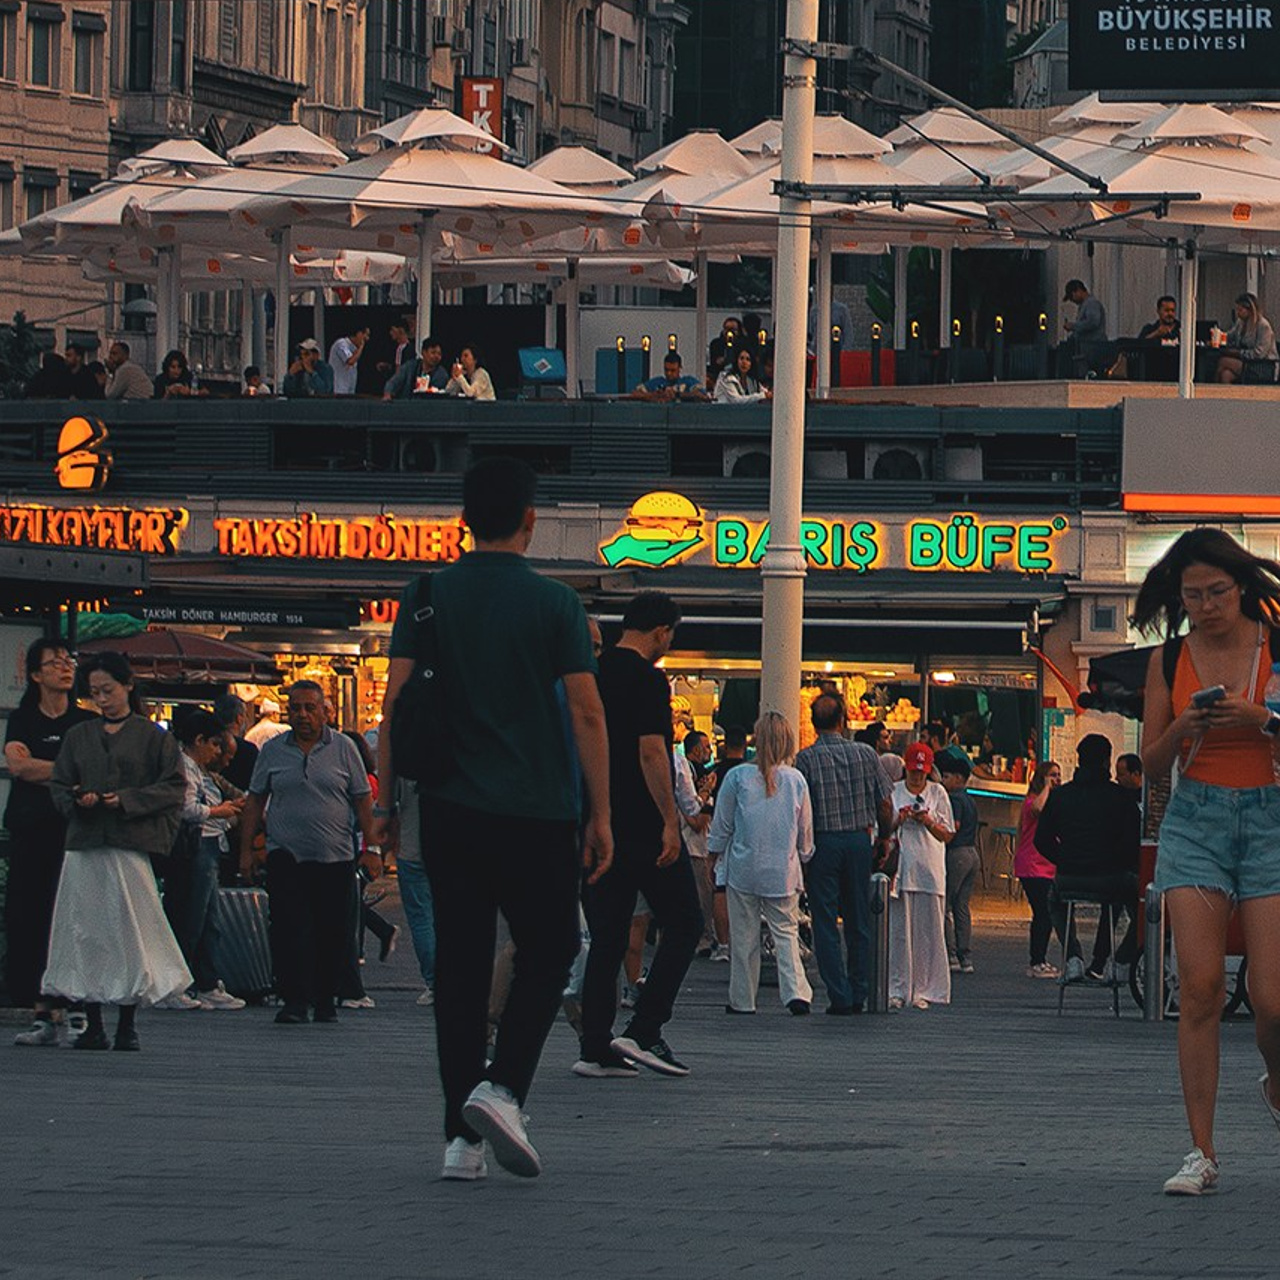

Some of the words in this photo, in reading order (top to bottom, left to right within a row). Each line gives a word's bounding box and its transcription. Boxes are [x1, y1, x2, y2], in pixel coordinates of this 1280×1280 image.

[1098, 4, 1273, 32] BÜYÜKŞEHİR
[1125, 34, 1246, 51] BELEDİYESİ
[214, 513, 340, 557] TAKSİM
[346, 514, 466, 561] DÖNER
[911, 515, 1053, 569] BÜFE
[220, 610, 279, 623] HAMBURGER
